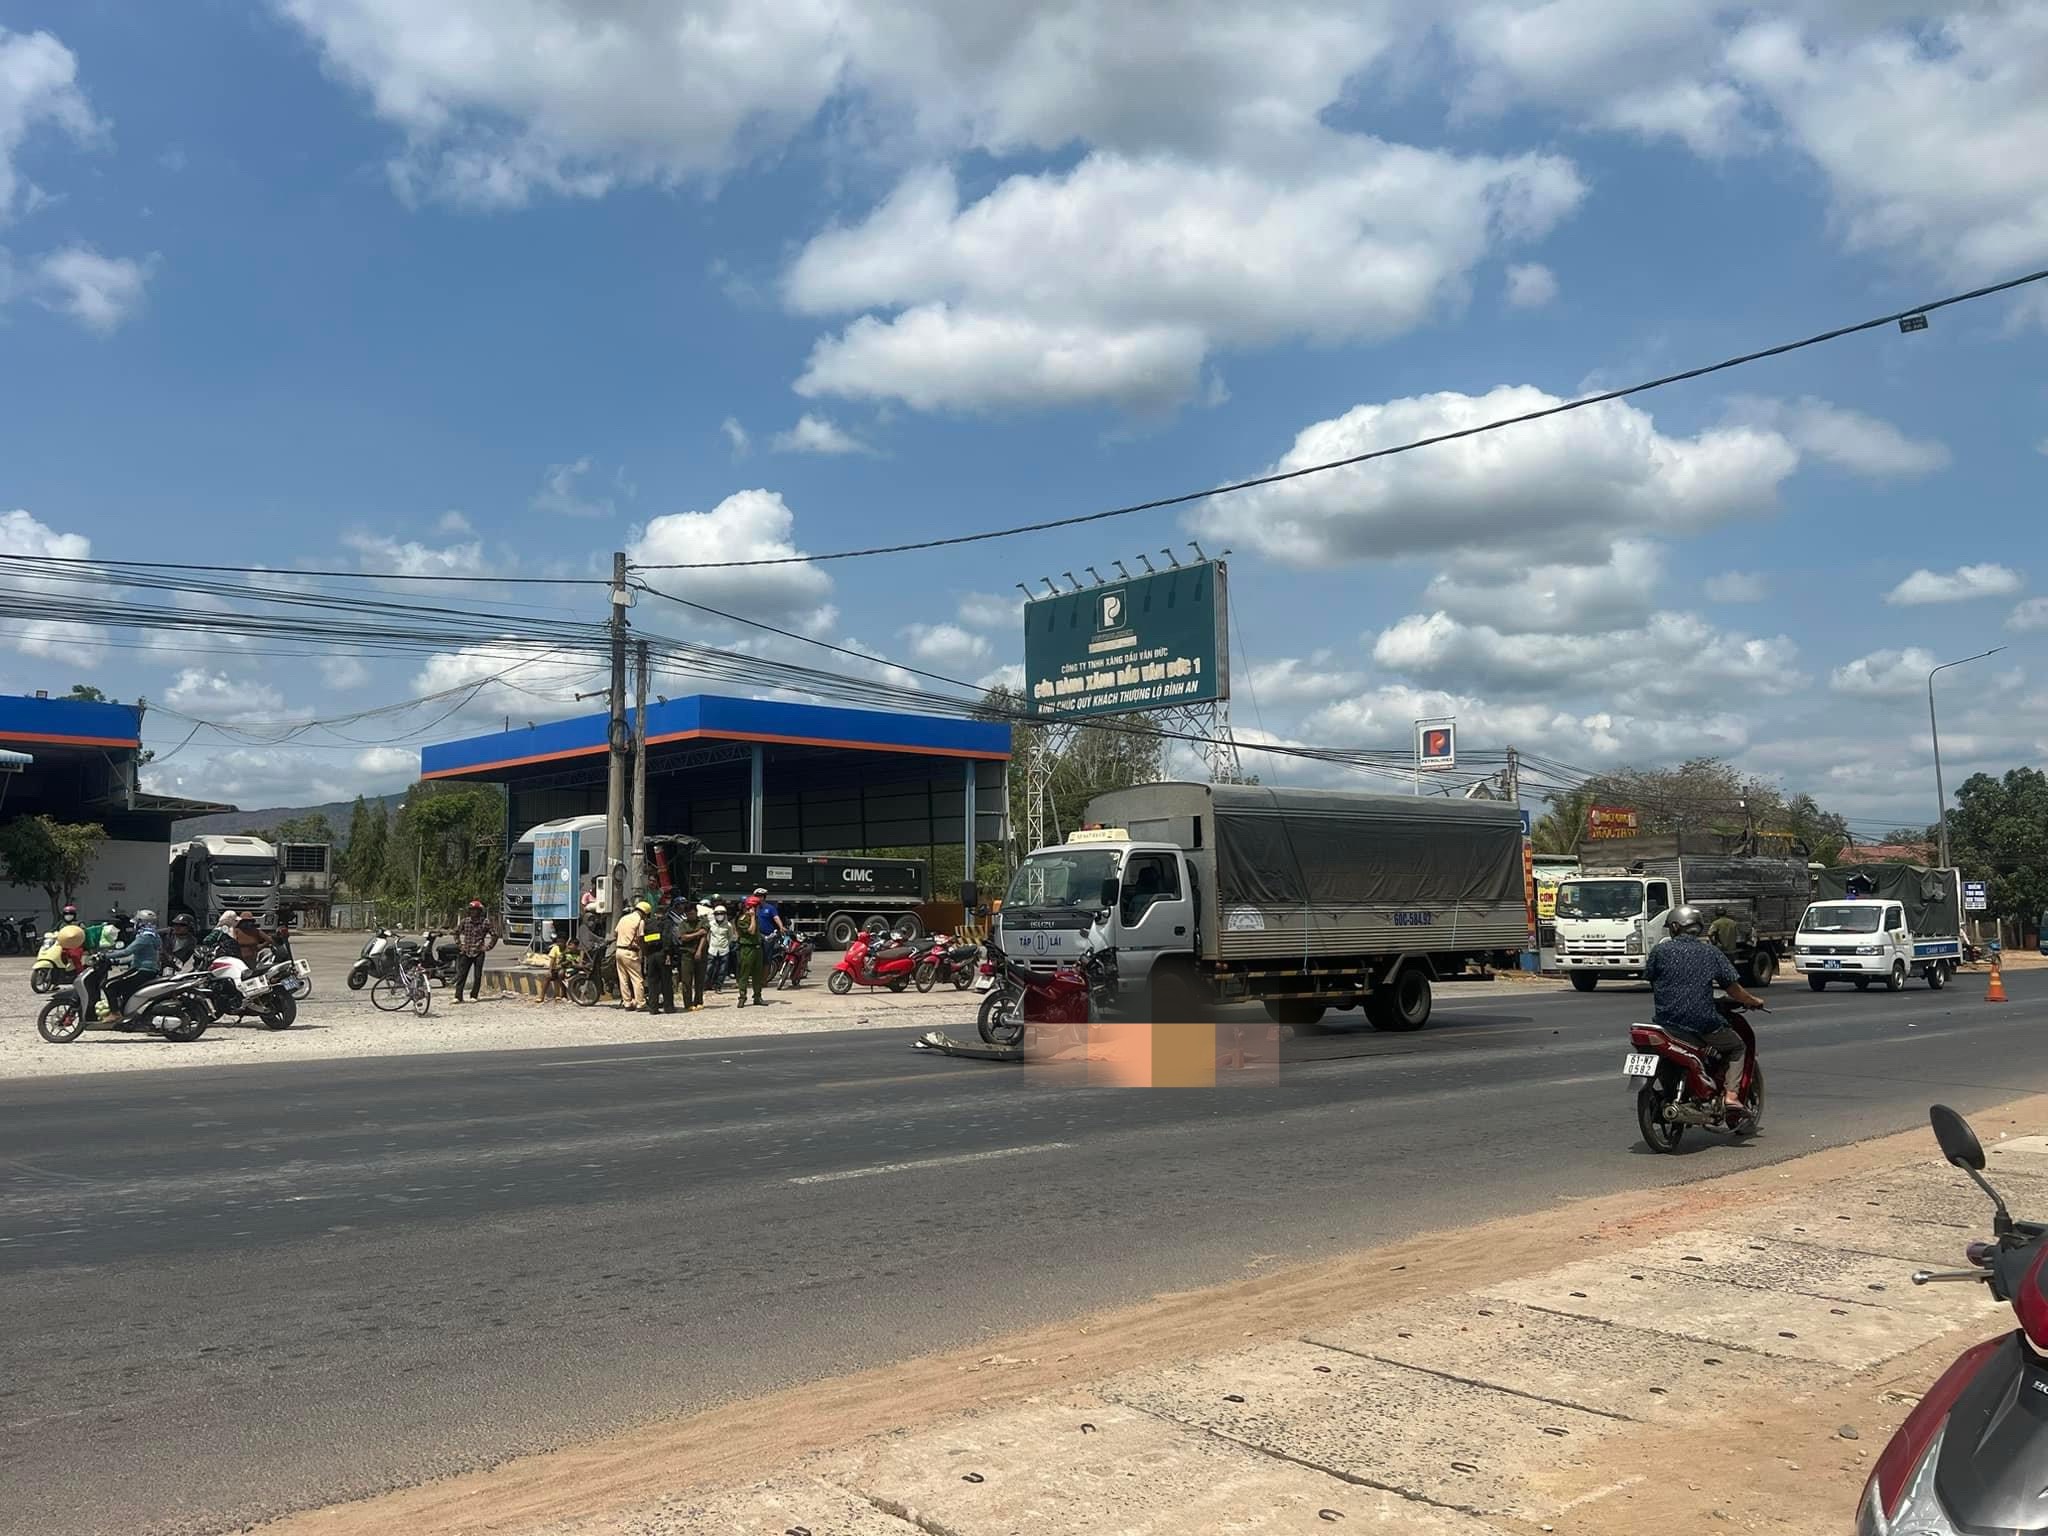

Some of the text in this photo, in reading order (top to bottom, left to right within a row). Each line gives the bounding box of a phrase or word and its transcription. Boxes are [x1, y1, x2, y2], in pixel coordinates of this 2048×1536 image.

[1079, 661, 1087, 671] TY
[1087, 658, 1104, 669] TNHH
[1193, 657, 1201, 674] 1
[1151, 683, 1163, 701] LỘ
[1185, 680, 1199, 693] AN
[842, 868, 873, 882] CIMC
